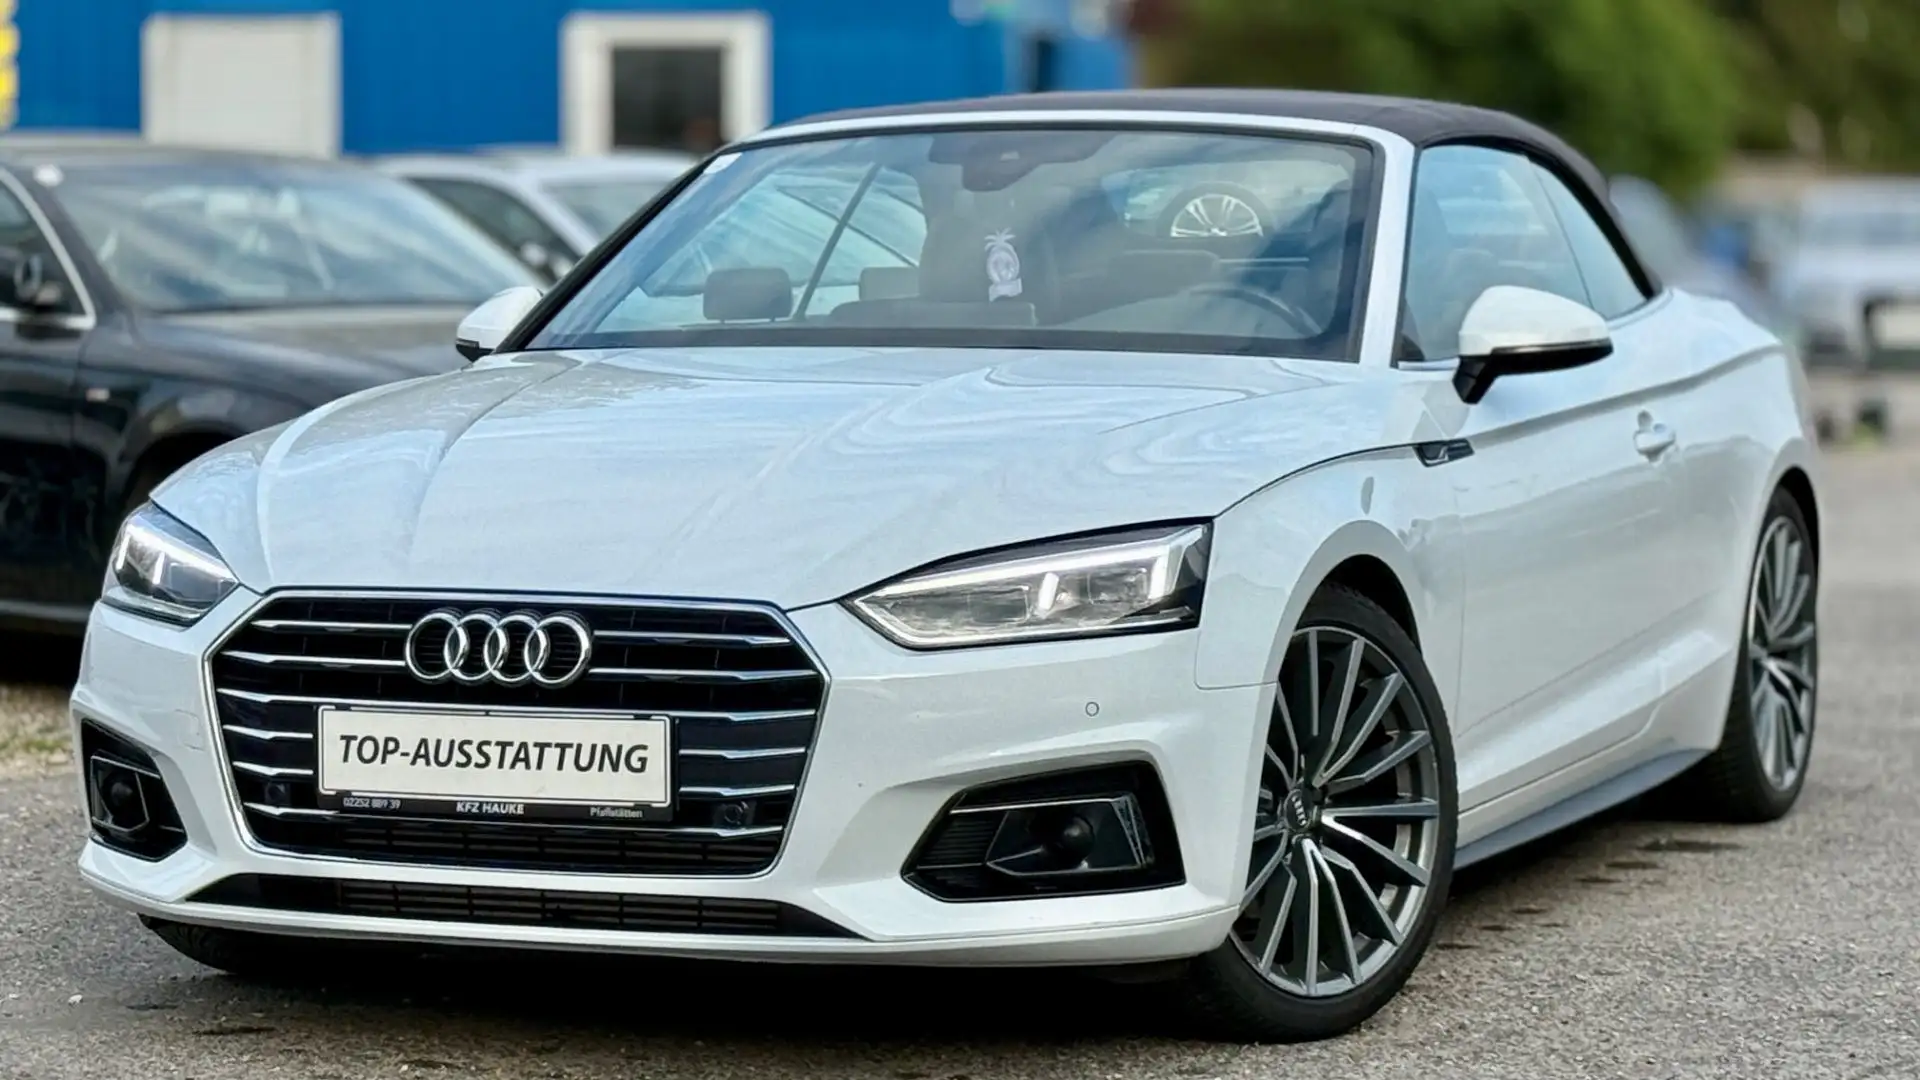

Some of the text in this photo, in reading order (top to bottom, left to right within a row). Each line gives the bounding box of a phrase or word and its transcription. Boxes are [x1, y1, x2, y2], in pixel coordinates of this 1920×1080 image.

[340, 734, 649, 773] TOP-AUSSTATTUNG
[456, 801, 525, 814] KFZ HAUKE
